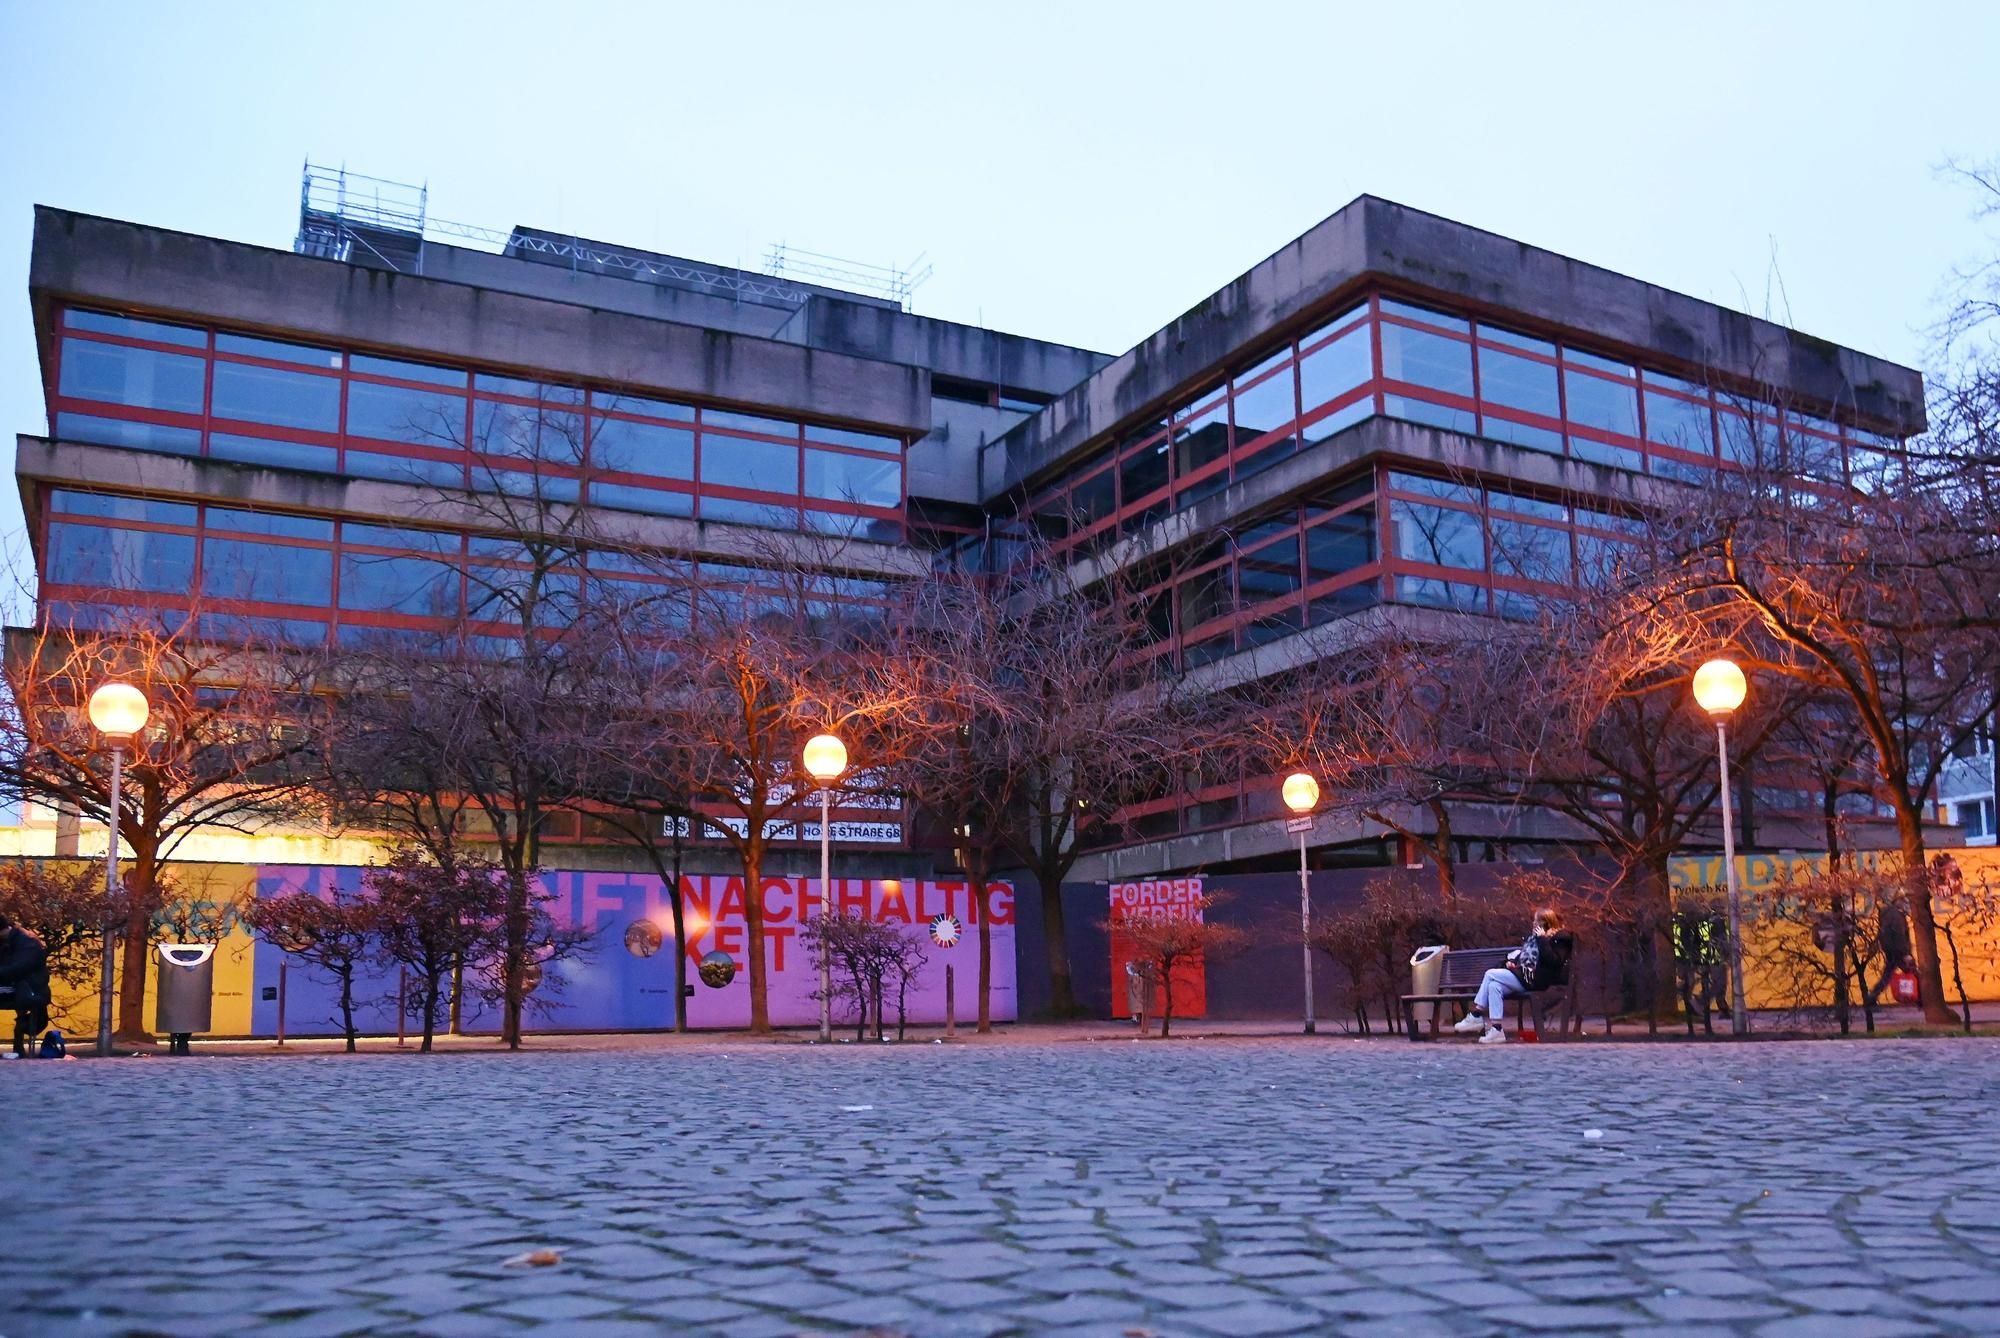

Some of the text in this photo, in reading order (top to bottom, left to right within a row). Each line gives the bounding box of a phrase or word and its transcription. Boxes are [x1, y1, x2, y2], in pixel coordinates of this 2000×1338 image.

[664, 821, 687, 832] BS
[804, 826, 837, 837] HOE
[886, 828, 900, 838] 68
[680, 875, 1016, 925] NACHHALTIG
[683, 926, 796, 972] KET
